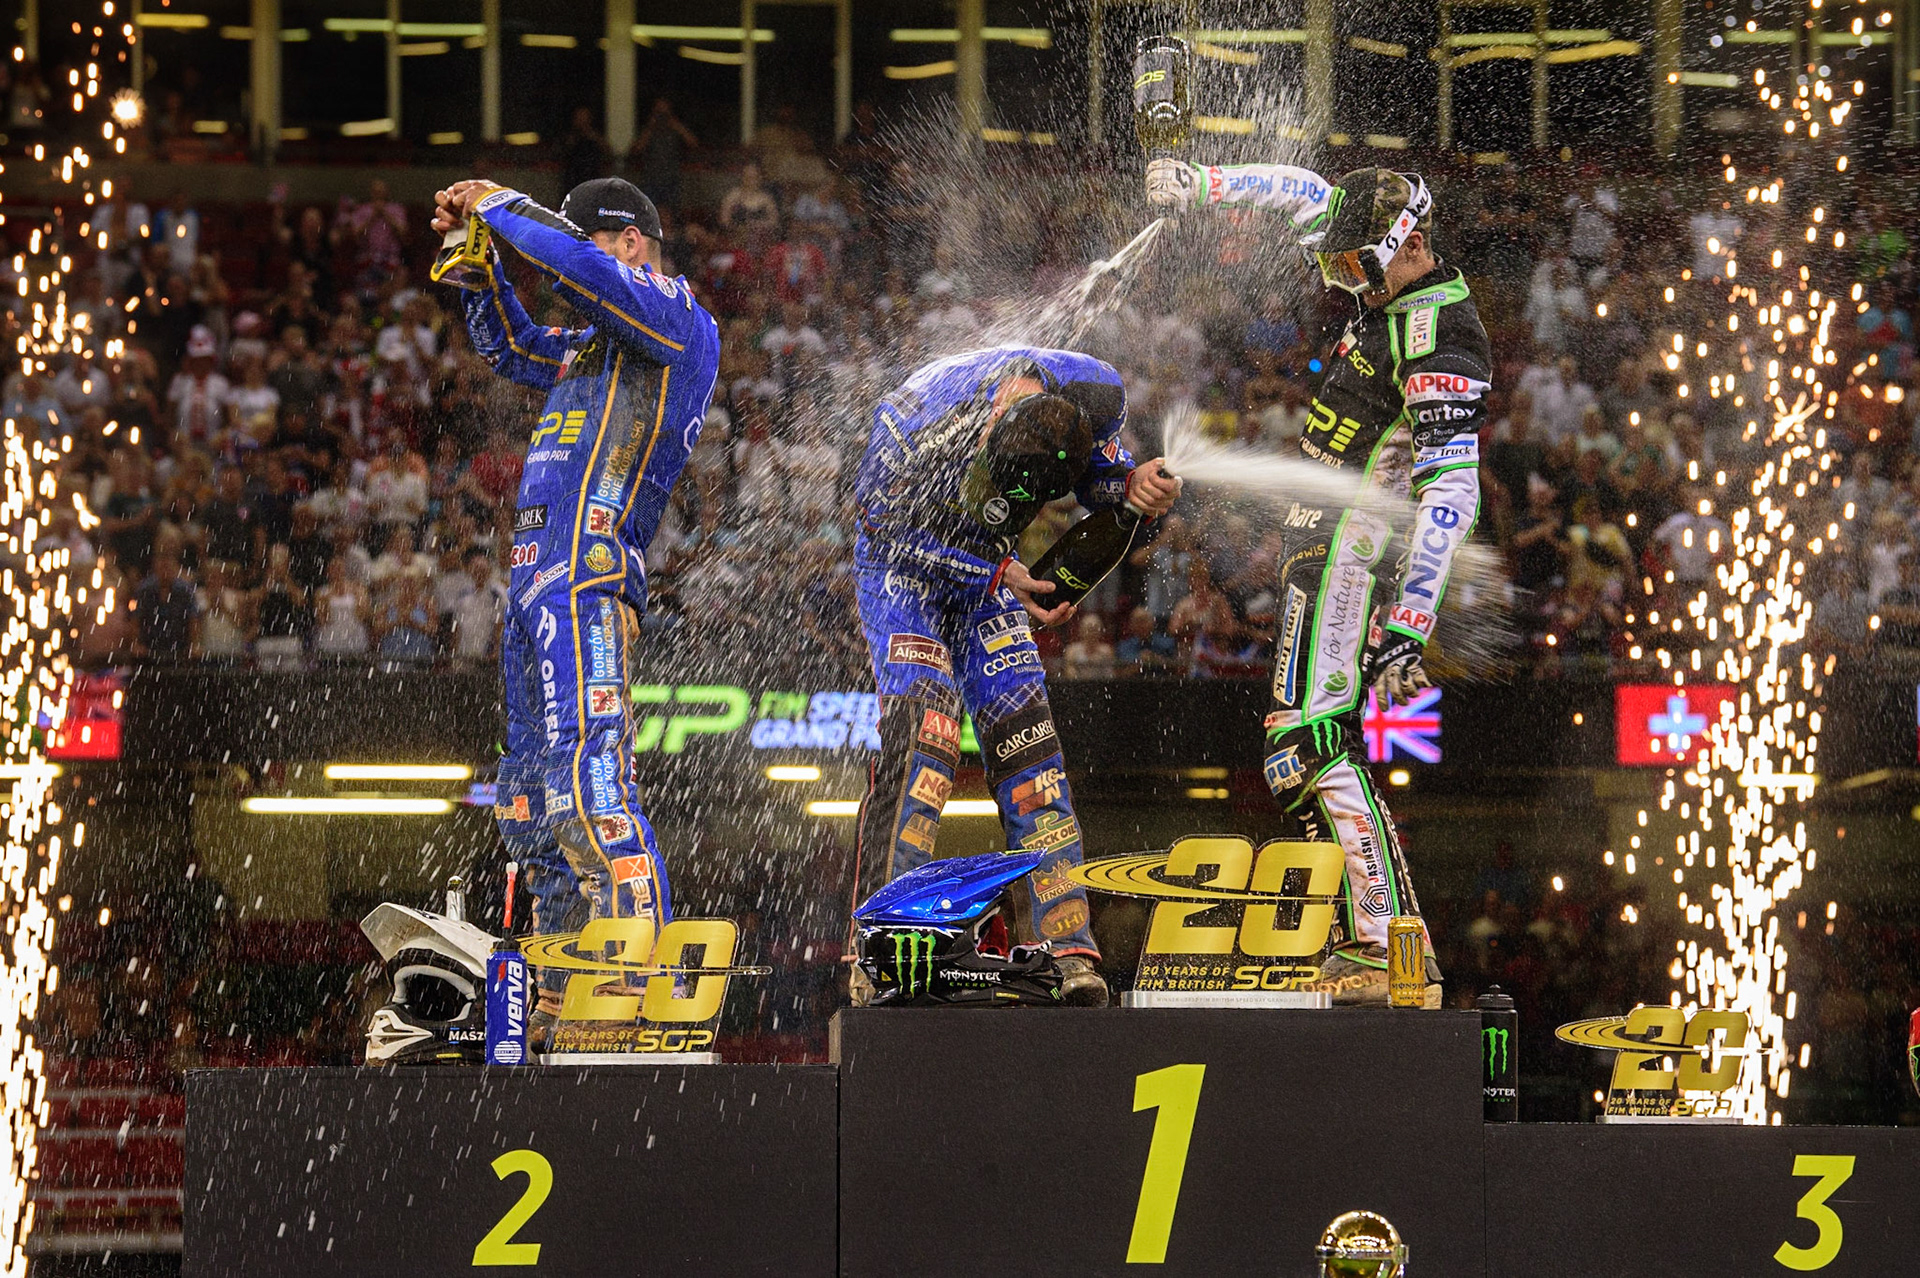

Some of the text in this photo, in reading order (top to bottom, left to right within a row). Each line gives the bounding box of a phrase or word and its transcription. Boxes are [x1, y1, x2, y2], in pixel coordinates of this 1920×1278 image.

[1399, 292, 1446, 309] MARWIS
[1349, 349, 1376, 378] SGP
[549, 449, 571, 462] PRIX
[1320, 451, 1345, 470] PRIX
[1440, 446, 1472, 457] Truck
[1404, 506, 1460, 600] Nice
[1055, 566, 1089, 590] SGP
[1323, 566, 1356, 667] for Nature
[594, 624, 603, 678] GORZÓW
[1274, 645, 1294, 694] Truck
[595, 757, 607, 809] GORZÓW
[1267, 755, 1305, 785] POL
[1283, 776, 1301, 789] 1991
[1060, 825, 1078, 841] OIL
[1353, 814, 1380, 883] JASINSKI BDV
[1145, 837, 1346, 957] 20
[560, 917, 737, 1022] 20
[939, 970, 1001, 982] MONSTER
[1142, 966, 1231, 977] 20 YEARS OF
[1230, 965, 1321, 991] SGP
[1138, 979, 1226, 990] FIM BRITISH
[507, 960, 523, 1037] verva
[552, 1043, 628, 1053] FIM BRITISH
[556, 1030, 634, 1041] 20 YEARS OF
[634, 1029, 713, 1052] SGP
[1611, 1008, 1751, 1091] 20
[1607, 1106, 1668, 1116] FIM BRITISH
[1610, 1097, 1672, 1106] 20 YEARS OF
[1125, 1063, 1207, 1264] 1
[471, 1149, 554, 1267] 2
[1772, 1154, 1857, 1271] 3
